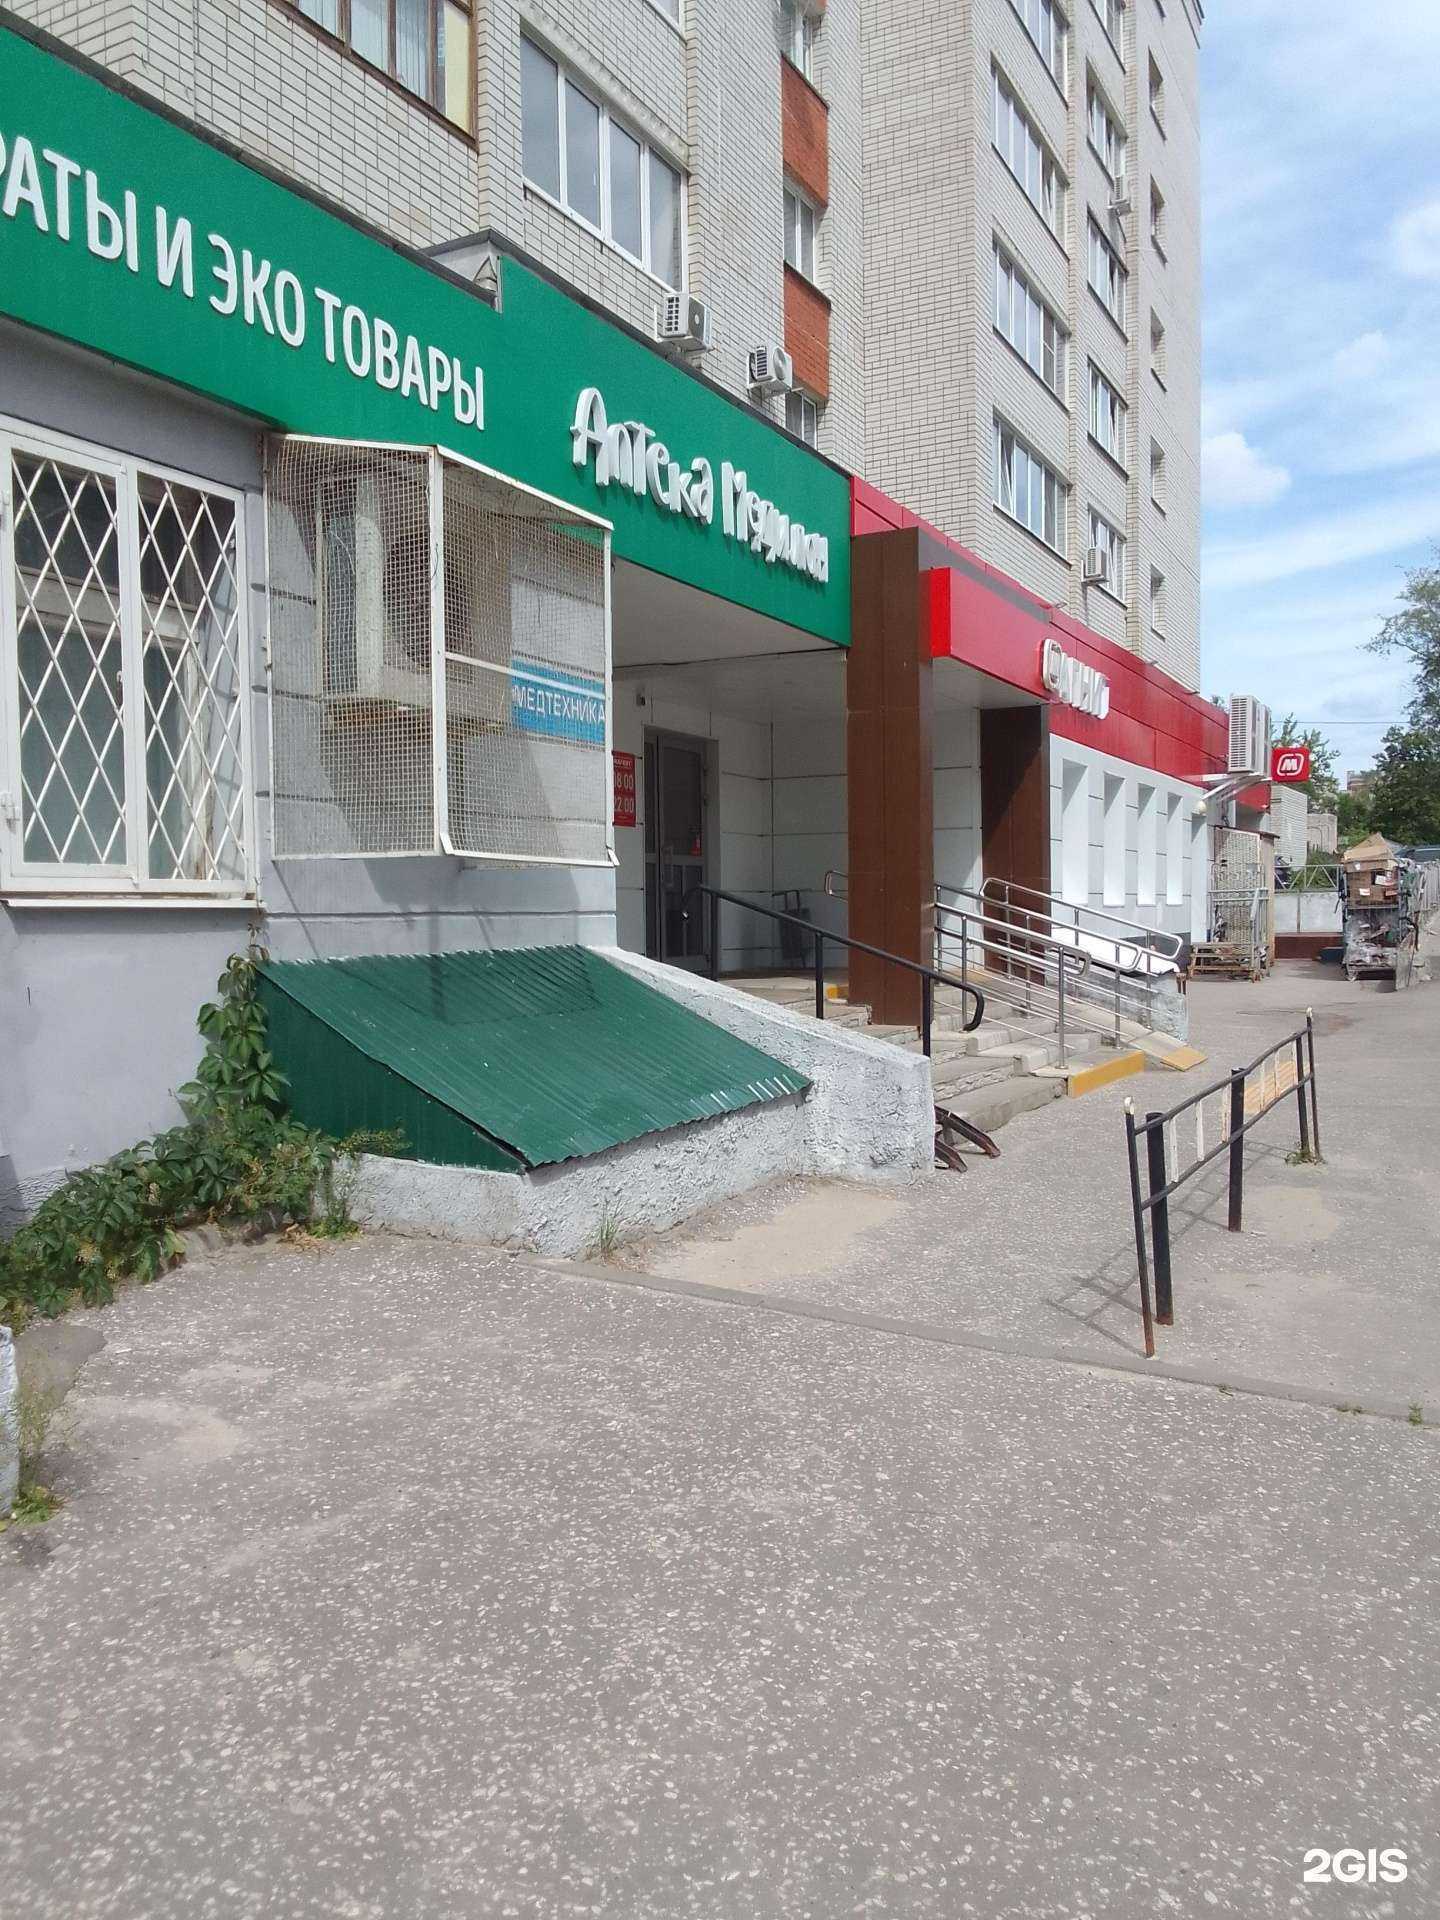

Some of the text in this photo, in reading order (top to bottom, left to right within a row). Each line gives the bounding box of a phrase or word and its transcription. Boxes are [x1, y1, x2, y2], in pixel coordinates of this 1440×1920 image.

[0, 130, 486, 431] АТЫ И ЭКО ТОВАРЫ
[569, 386, 714, 526] Аптека
[512, 684, 605, 724] МЕДТЕХНИКА
